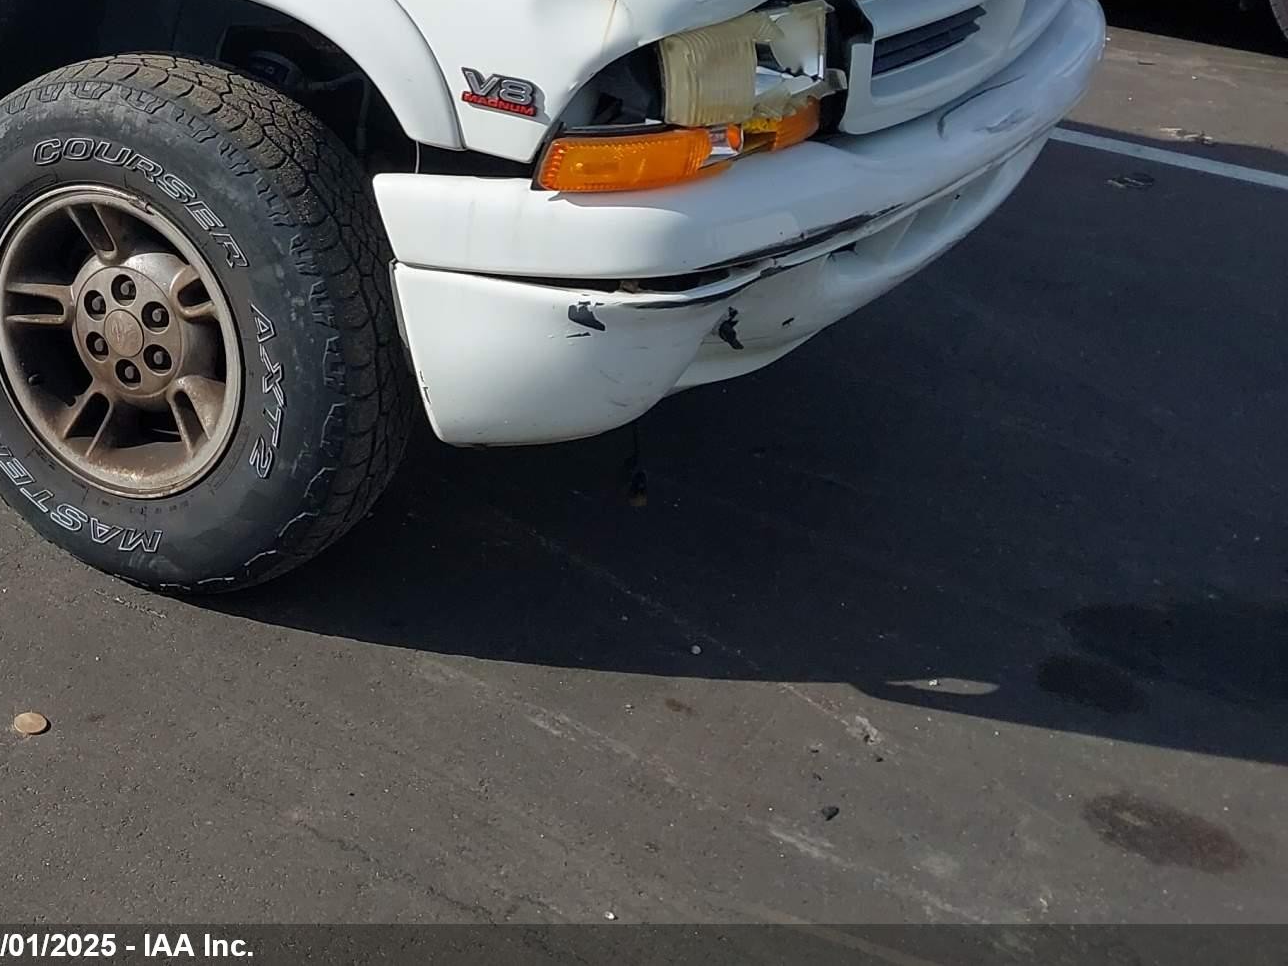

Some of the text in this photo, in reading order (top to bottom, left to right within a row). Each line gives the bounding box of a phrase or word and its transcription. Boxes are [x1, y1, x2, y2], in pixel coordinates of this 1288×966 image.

[463, 69, 534, 105] V8
[463, 92, 536, 116] MAGNUM
[32, 136, 250, 270] COURSER
[249, 304, 288, 480] AXT2
